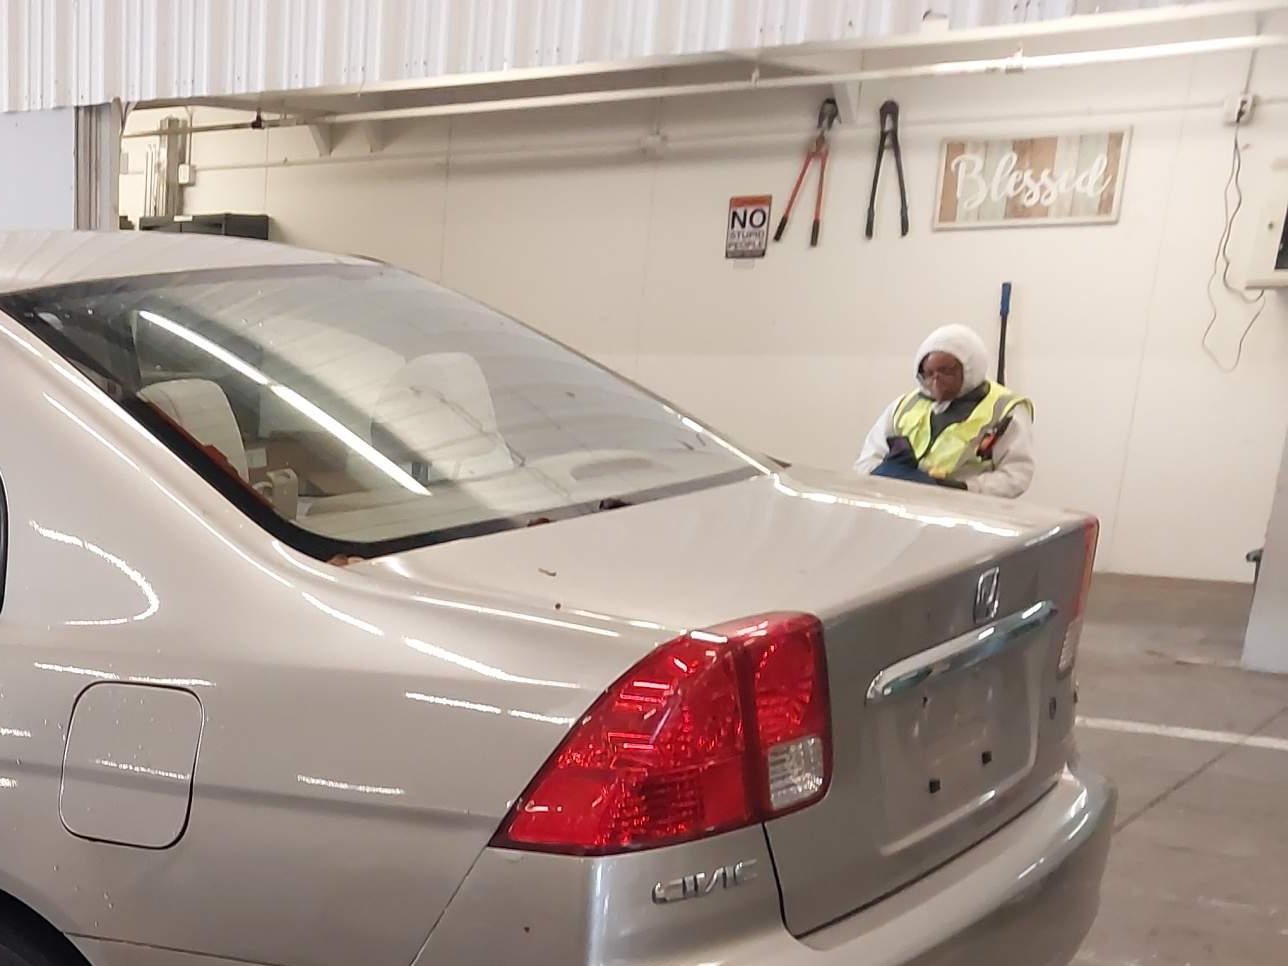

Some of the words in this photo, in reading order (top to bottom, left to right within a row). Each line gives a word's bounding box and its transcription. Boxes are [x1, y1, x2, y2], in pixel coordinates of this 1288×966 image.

[950, 151, 1113, 210] Blessed
[731, 208, 767, 230] NO
[652, 859, 758, 904] CIVIC
